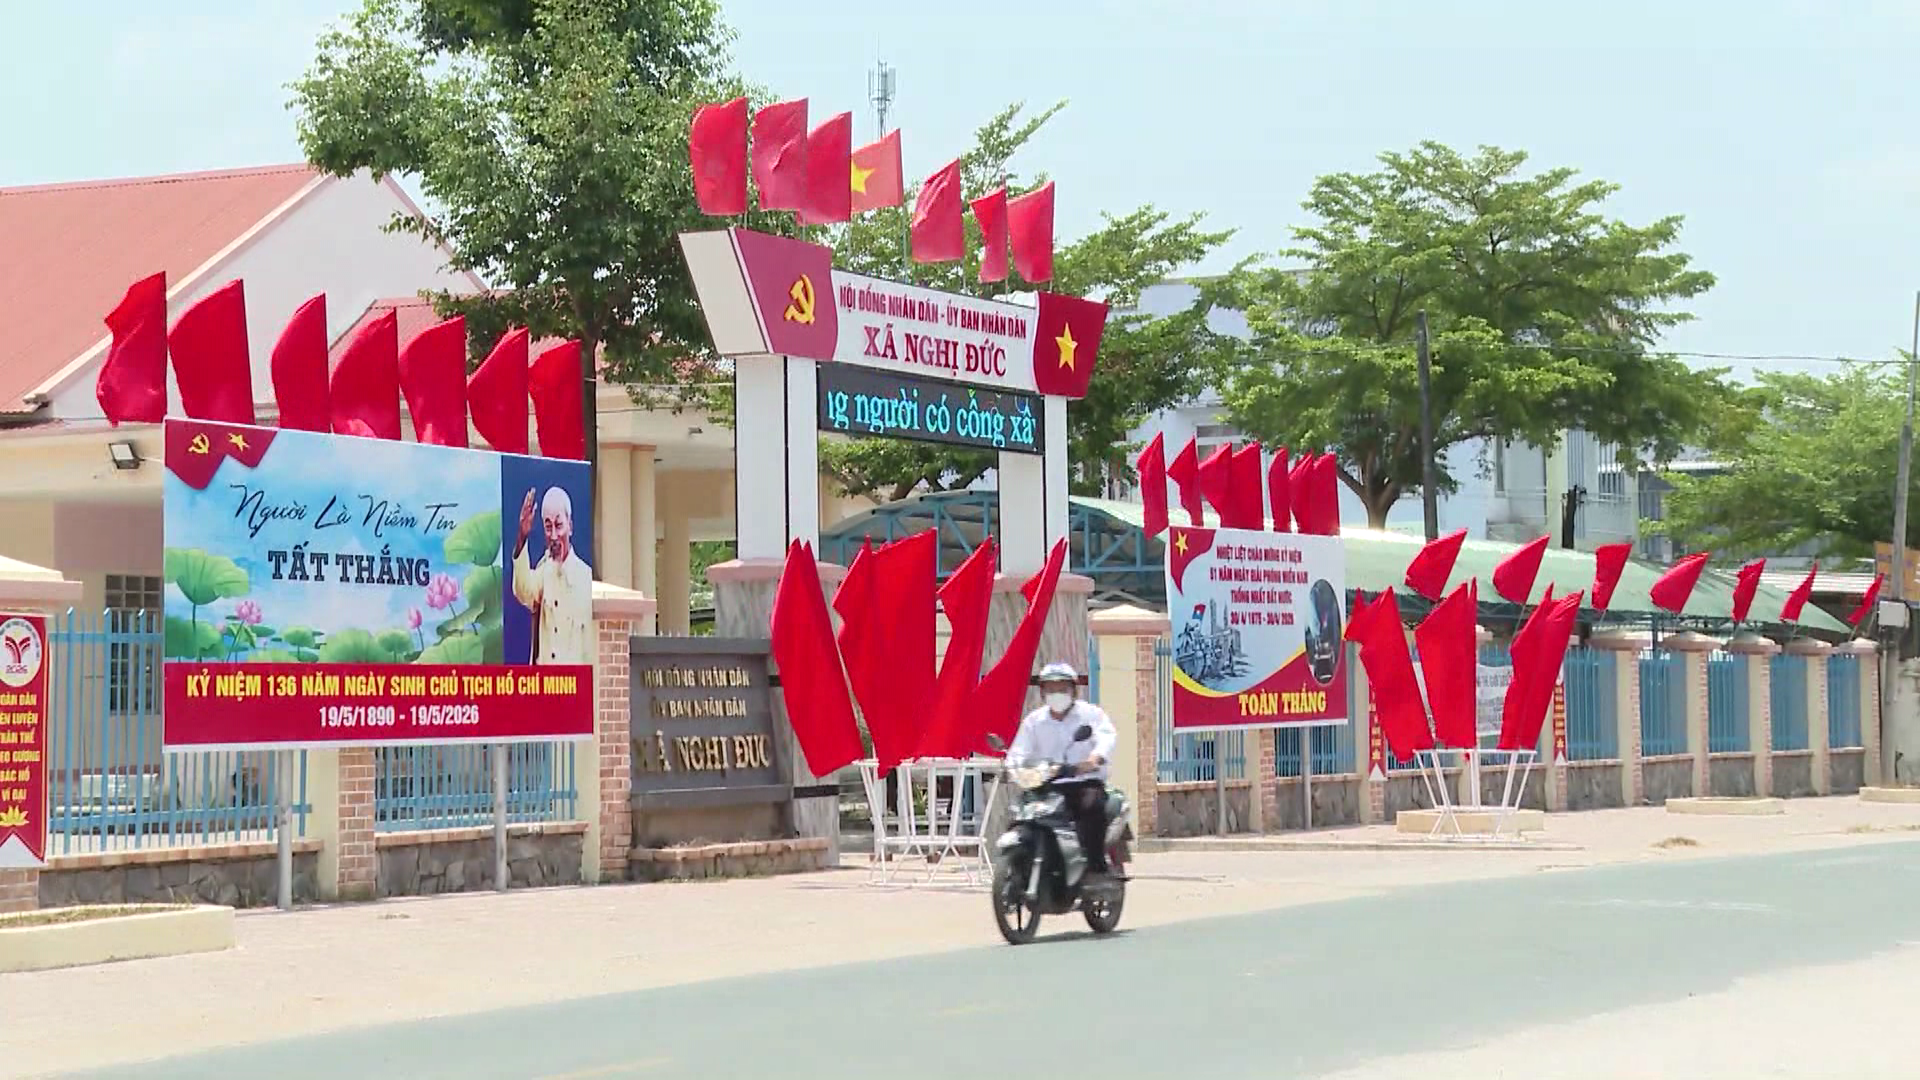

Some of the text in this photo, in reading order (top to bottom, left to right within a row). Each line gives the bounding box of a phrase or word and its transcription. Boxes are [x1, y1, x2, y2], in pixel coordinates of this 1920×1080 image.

[840, 283, 856, 313] HỘI
[889, 293, 916, 320] NHÂN
[918, 297, 938, 324] DÂN
[961, 309, 979, 332] BAN
[981, 311, 1006, 336] NHÂN
[1008, 315, 1026, 339] DÂN
[864, 323, 1006, 377] XÃ NGHỊ ĐỨC
[854, 388, 920, 434] người
[925, 394, 951, 434] có
[230, 485, 459, 539] Người Là Niềm Tin
[268, 541, 430, 587] TẤT THẮNG
[1219, 565, 1233, 581] NĂM
[186, 668, 577, 702] KỶ NIỆM 136 NĂM NGÀY SINH CHỦ TỊCH HỒ CHÍ MINH
[1238, 682, 1326, 716] TOÀN THẮNG
[319, 705, 395, 727] 19/5/1890
[410, 704, 480, 726] 19/5/2026
[669, 700, 692, 717] BAN
